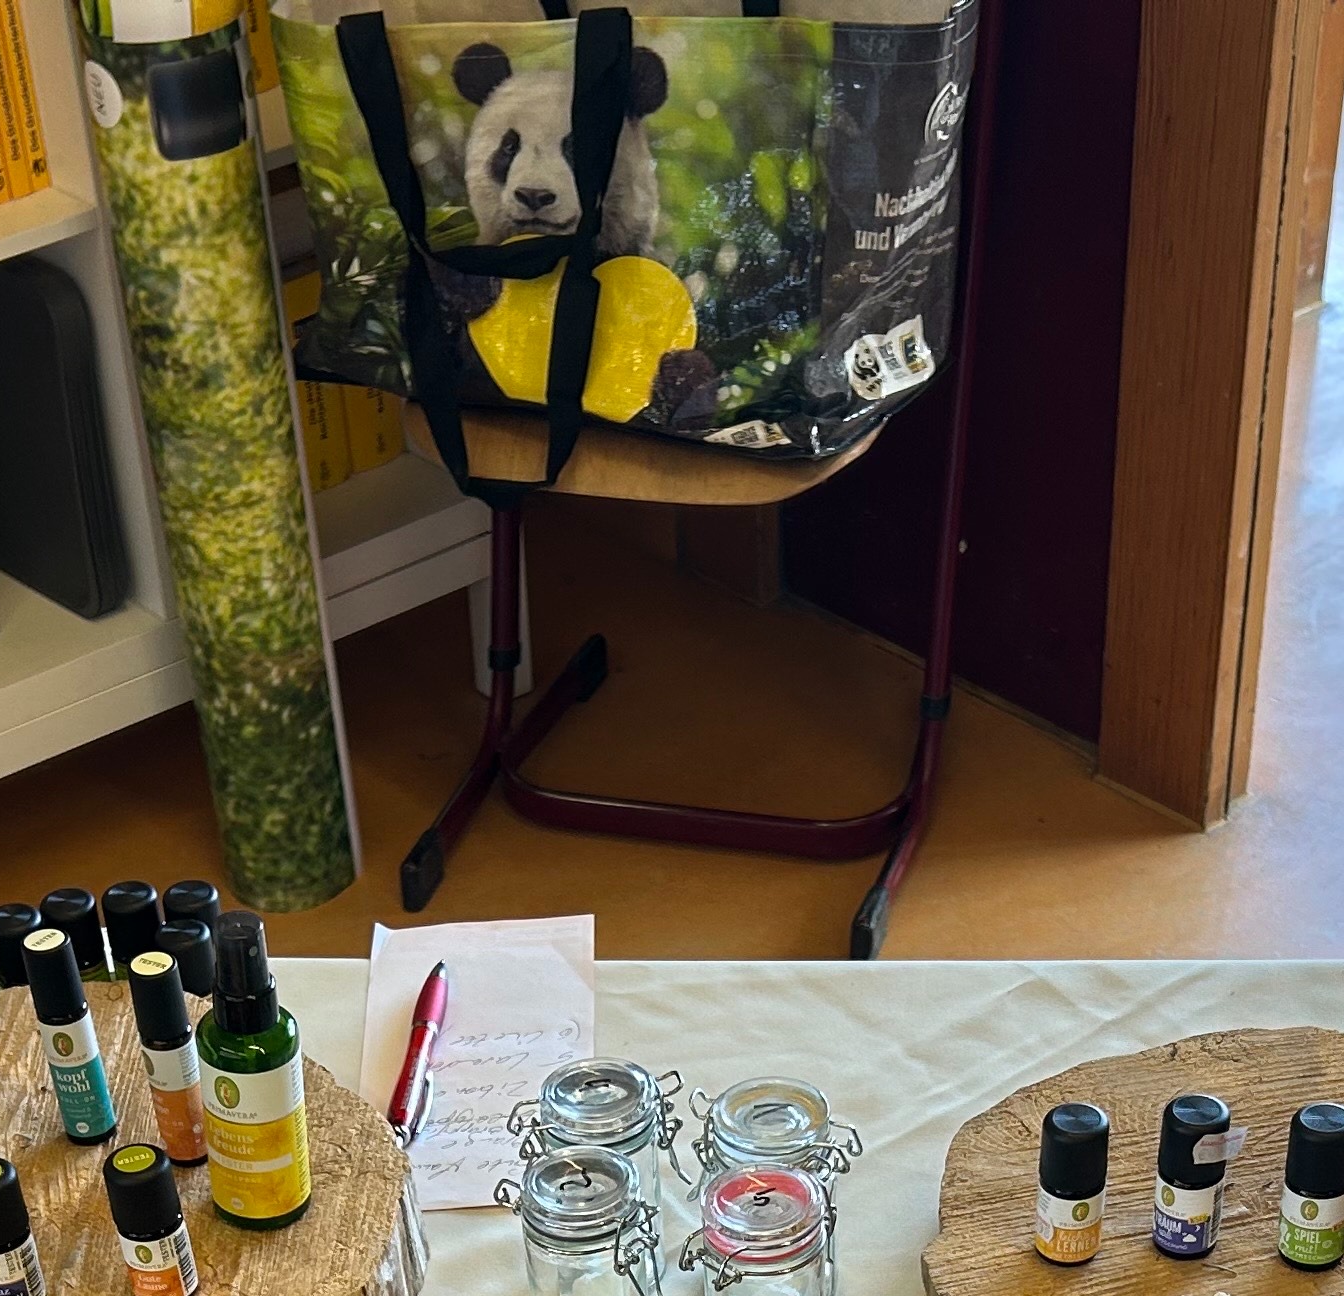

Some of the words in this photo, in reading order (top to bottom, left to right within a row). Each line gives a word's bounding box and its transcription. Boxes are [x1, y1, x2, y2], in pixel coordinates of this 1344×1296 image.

[855, 226, 892, 251] und
[31, 931, 57, 947] TESTER
[138, 957, 167, 970] TESTER
[55, 1068, 88, 1084] kopf
[57, 1080, 91, 1093] wohl
[213, 1138, 255, 1155] freude
[117, 1153, 151, 1165] TESTER
[753, 1187, 777, 1207] 5
[1294, 1229, 1321, 1244] SPIEL
[136, 1280, 168, 1291] Laune
